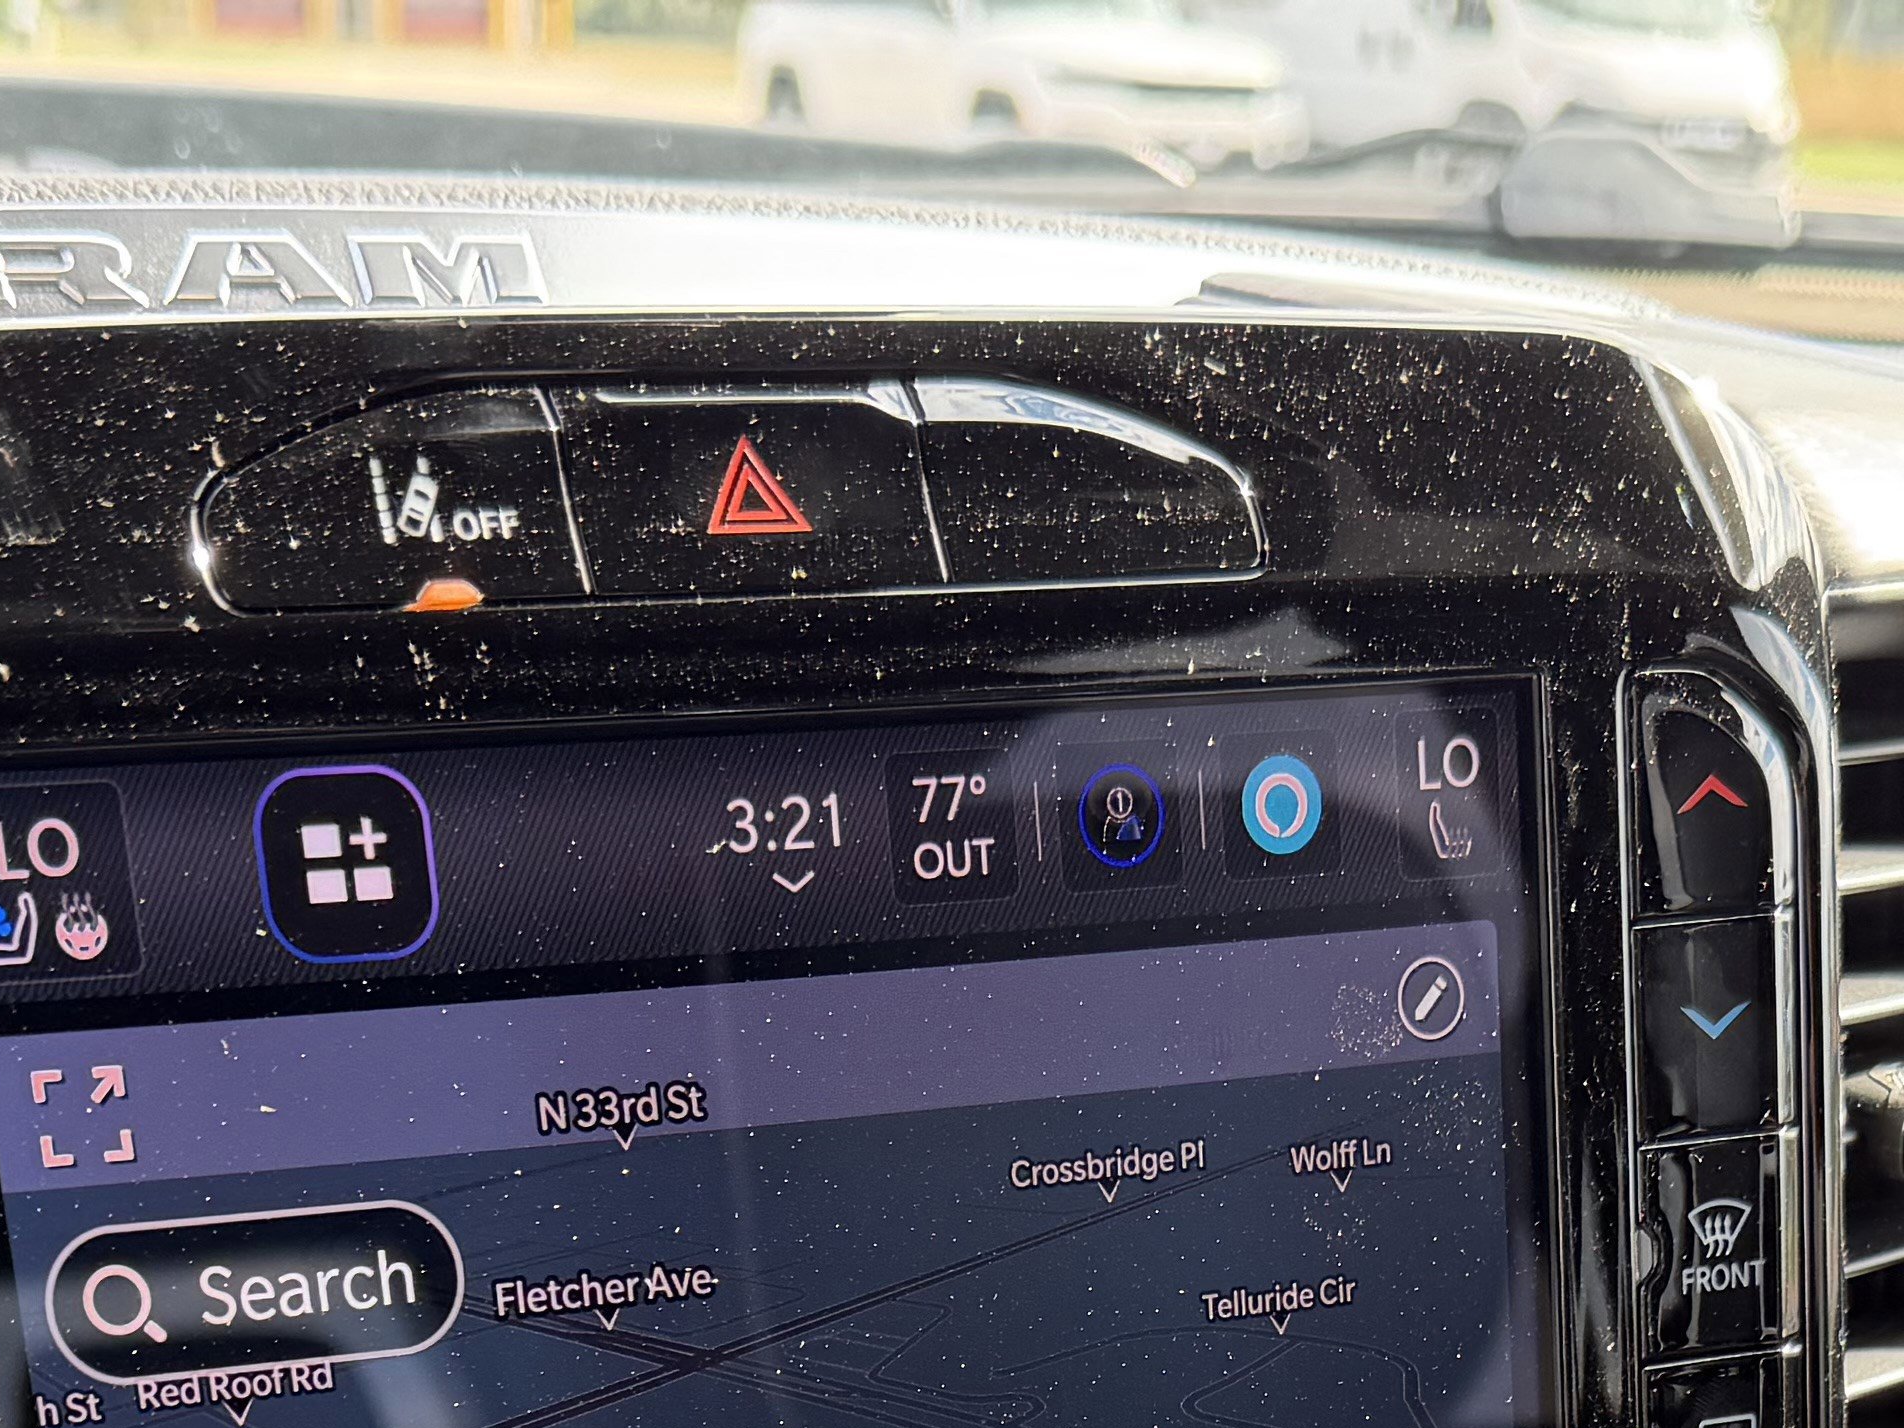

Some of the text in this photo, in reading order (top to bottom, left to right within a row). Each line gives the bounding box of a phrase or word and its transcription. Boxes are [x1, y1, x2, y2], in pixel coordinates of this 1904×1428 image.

[453, 508, 520, 542] OFF
[1417, 738, 1479, 791] LO
[912, 774, 987, 824] 77°
[725, 792, 843, 853] 3:21
[912, 837, 996, 880] OUT
[539, 1085, 704, 1131] N 33rd St
[1012, 1140, 1204, 1188] Crossbridge Pl
[1291, 1139, 1390, 1172] Wolff Ln
[200, 1250, 415, 1325] Search
[496, 1267, 712, 1317] Fletcher Ave
[1203, 1277, 1355, 1320] Telluride Cir
[1682, 1259, 1764, 1294] FRONT
[67, 1394, 102, 1423] St
[136, 1362, 334, 1409] Red Roof Rd
